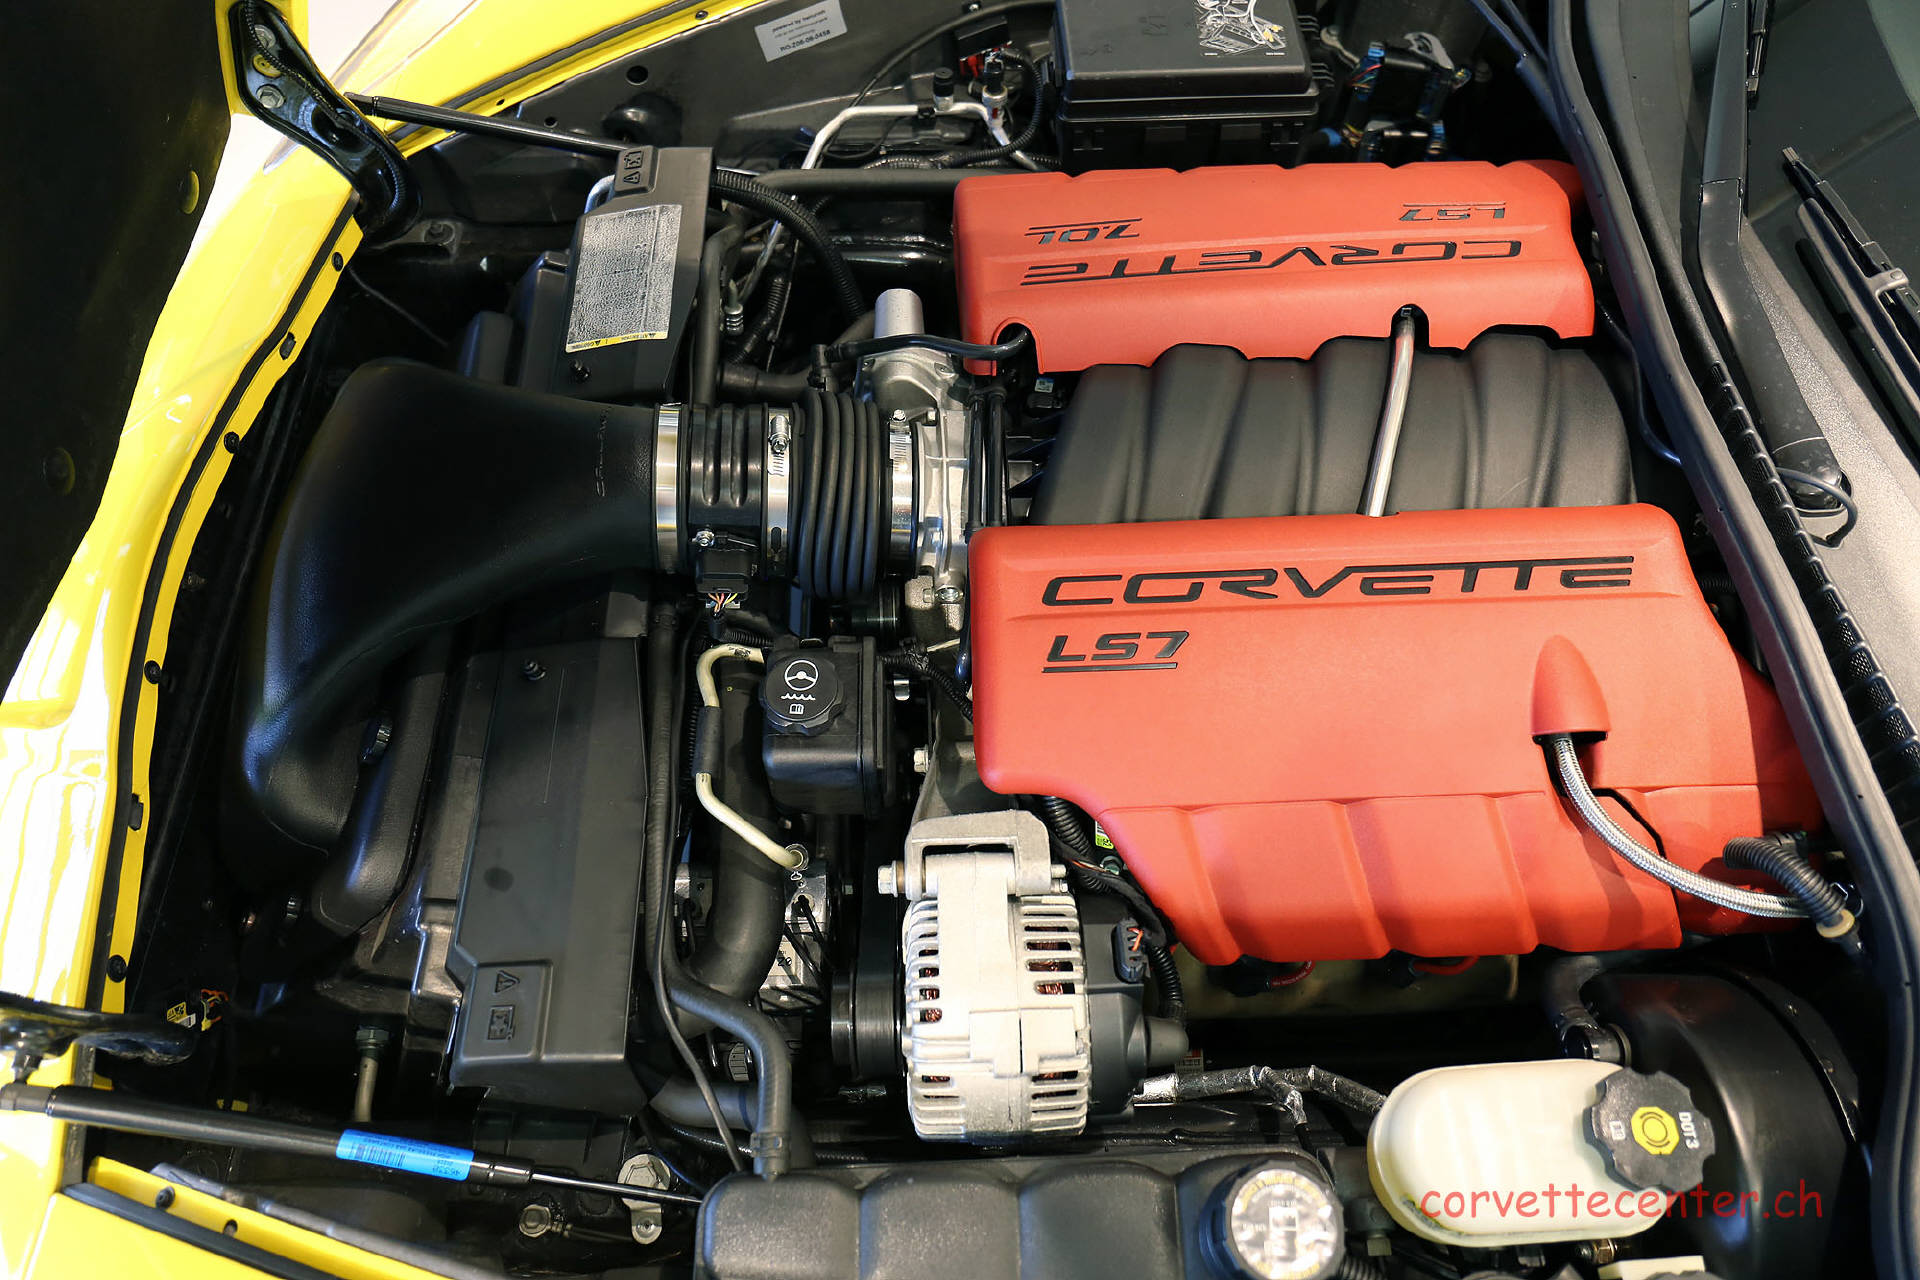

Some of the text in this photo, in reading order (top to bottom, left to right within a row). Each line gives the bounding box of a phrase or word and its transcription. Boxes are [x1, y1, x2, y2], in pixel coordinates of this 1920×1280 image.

[1024, 218, 1141, 245] 7.0L
[1400, 203, 1506, 221] LS7
[1020, 240, 1522, 285] CORVETTE
[1042, 556, 1634, 607] CORVETTE
[1043, 631, 1190, 673] LS7
